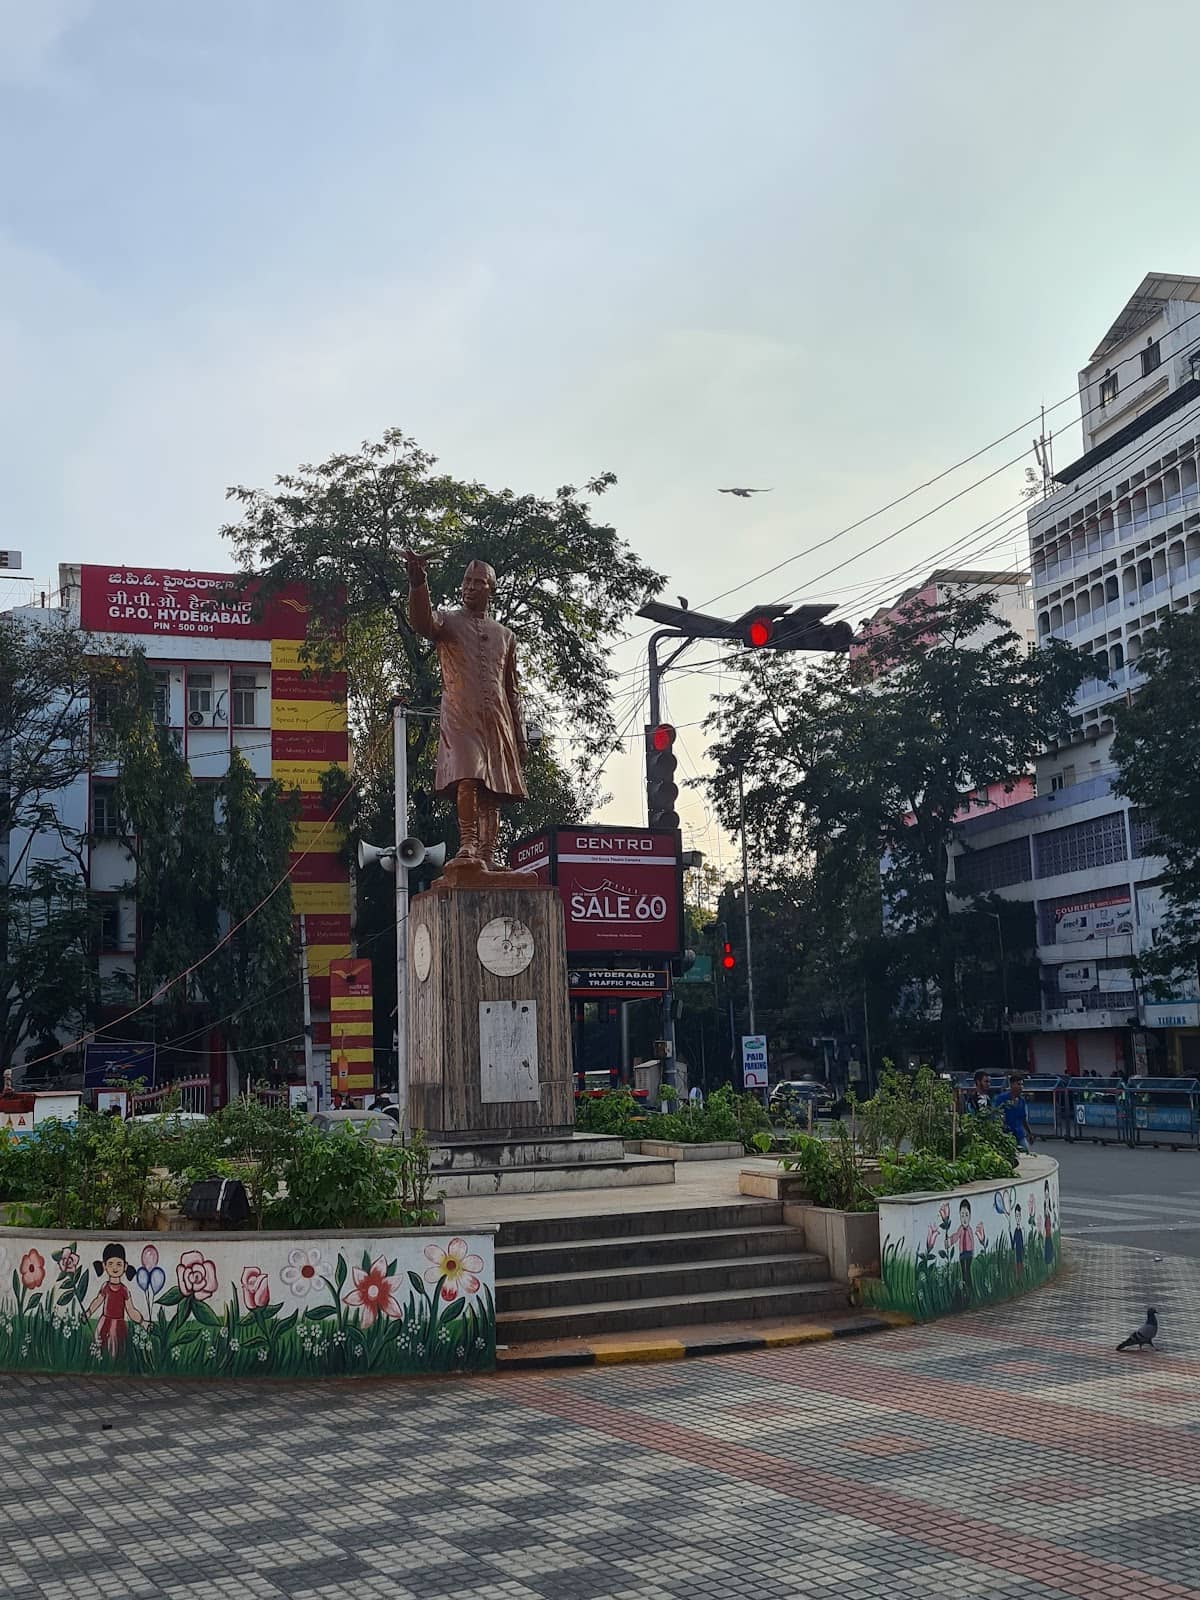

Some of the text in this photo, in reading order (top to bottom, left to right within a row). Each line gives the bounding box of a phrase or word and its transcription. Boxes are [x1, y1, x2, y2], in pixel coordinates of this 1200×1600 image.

[109, 606, 251, 625] G.P.O. HYDERABAD
[153, 621, 214, 633] PIN 500 001
[576, 837, 653, 851] CENTRO
[518, 841, 545, 862] CENTRO
[571, 895, 667, 920] SALE 60
[1055, 902, 1096, 915] COURIER
[588, 971, 656, 979] HYDERABAD
[746, 1052, 764, 1061] PAID
[744, 1061, 767, 1071] PARKING
